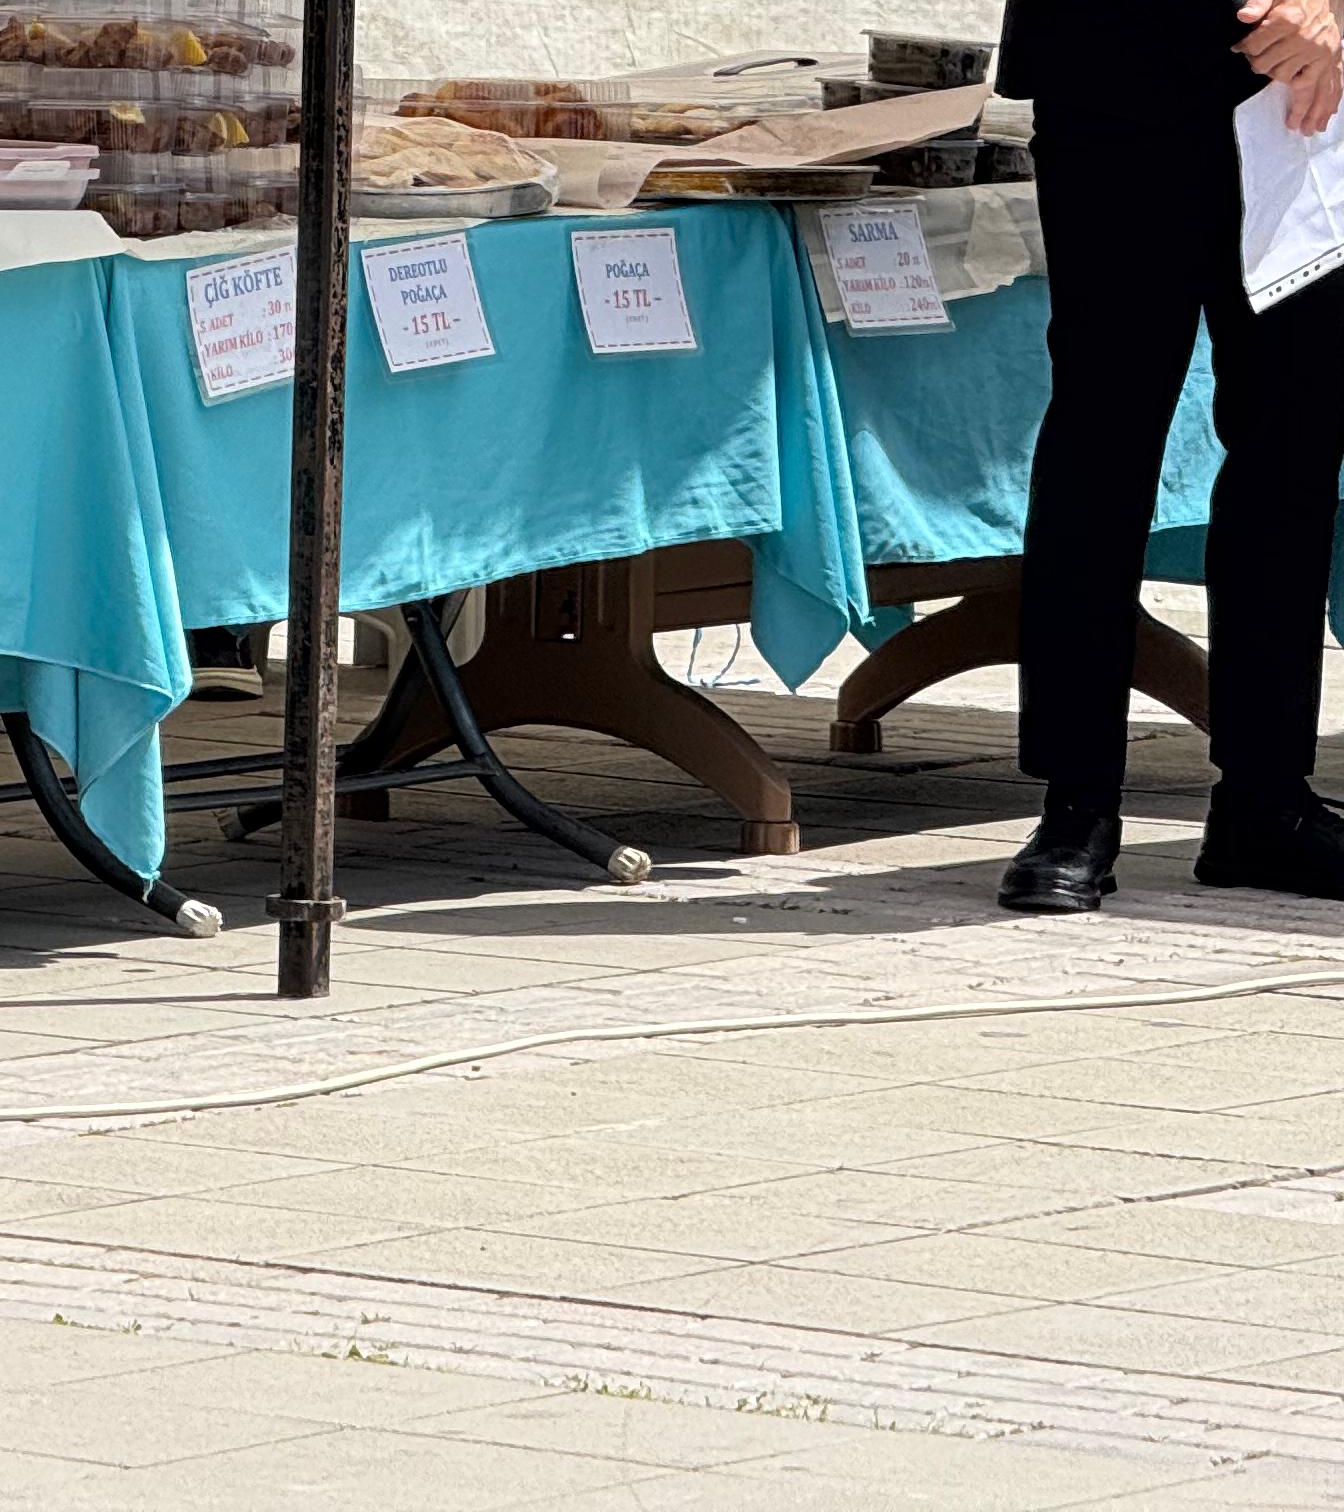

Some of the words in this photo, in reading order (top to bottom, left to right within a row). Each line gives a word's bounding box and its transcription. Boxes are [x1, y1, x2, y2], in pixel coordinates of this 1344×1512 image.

[848, 221, 899, 243] SARMA
[388, 258, 448, 282] DEREOTLU
[605, 260, 650, 281] POĞAÇA
[204, 276, 230, 309] ÇİĞ
[232, 267, 283, 297] KÖFTE
[400, 284, 447, 305] POĞAÇA
[613, 290, 630, 309] 15
[633, 289, 651, 307] TL
[210, 314, 234, 332] ADET
[412, 315, 429, 335] 15
[431, 311, 451, 331] TL
[204, 337, 238, 358] YARIM
[239, 330, 263, 348] KİLO
